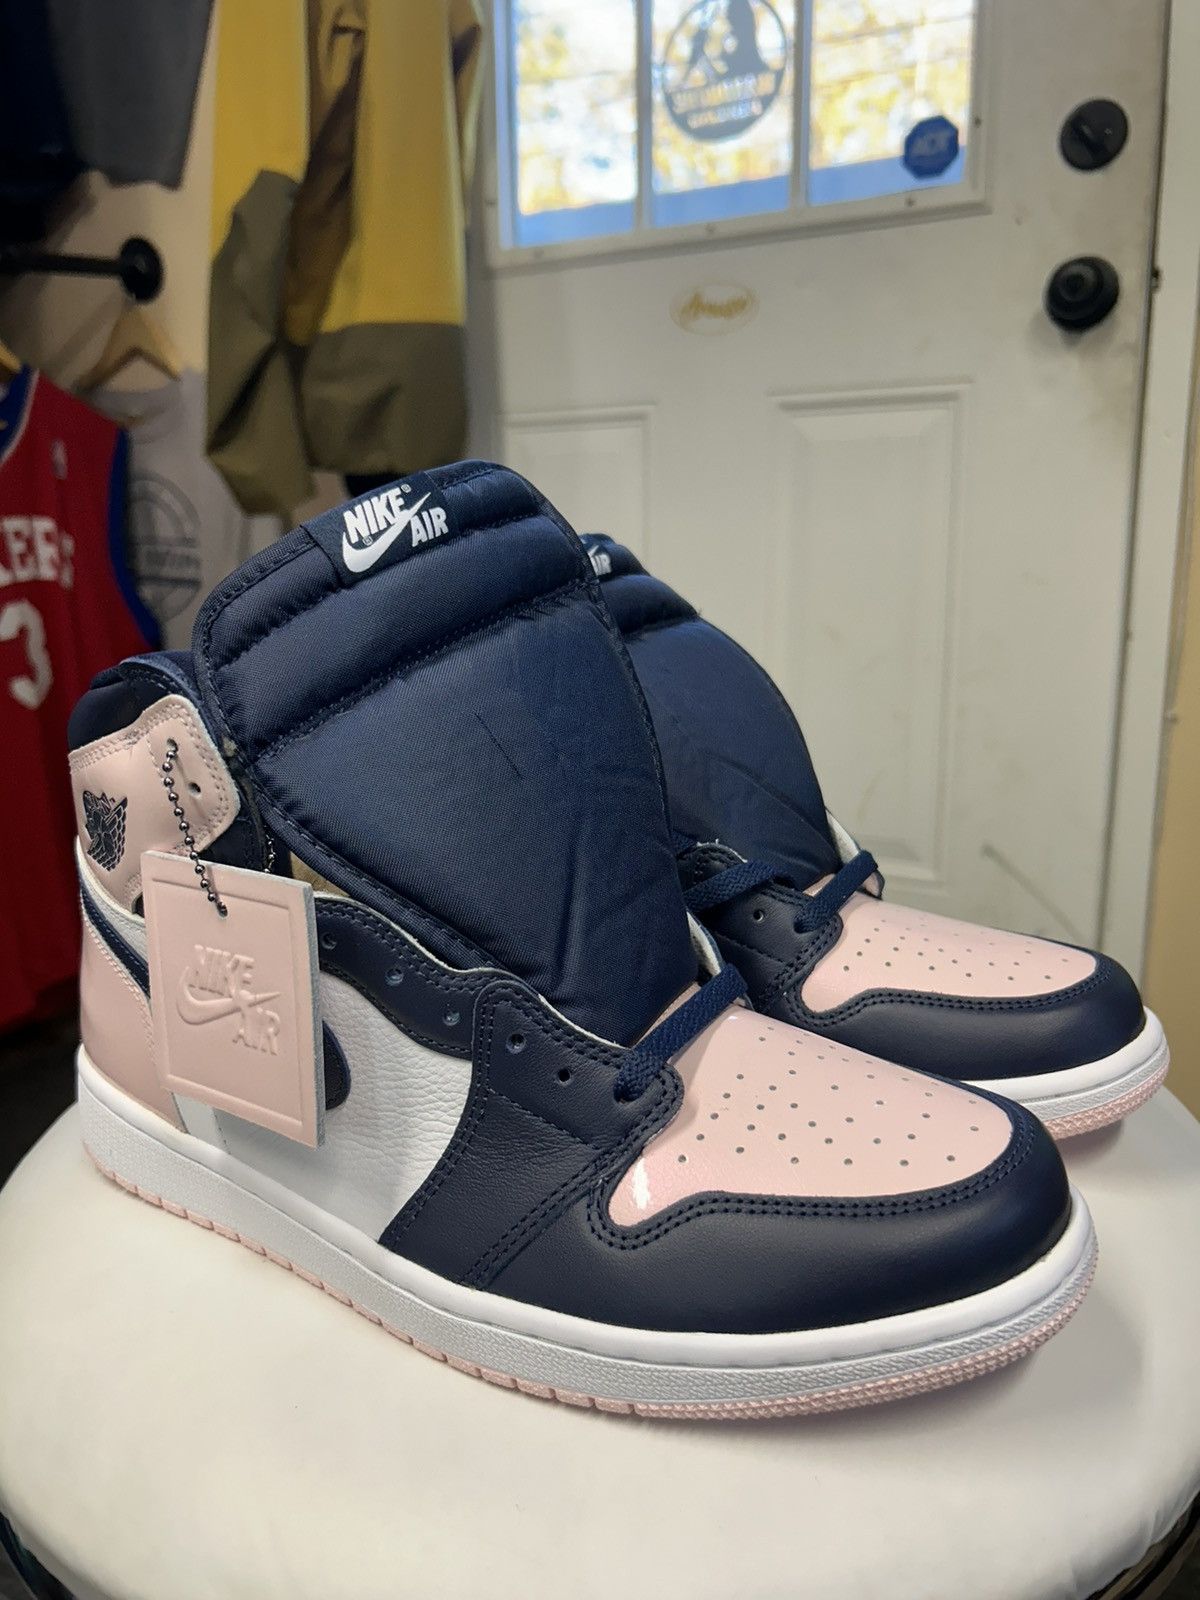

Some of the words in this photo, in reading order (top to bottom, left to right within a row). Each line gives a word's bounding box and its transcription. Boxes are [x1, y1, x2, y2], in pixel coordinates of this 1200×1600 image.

[343, 487, 406, 544] NIKE
[410, 507, 449, 547] AIR
[0, 599, 53, 710] 3
[188, 944, 255, 999] NIKE
[232, 1006, 280, 1056] AIR
